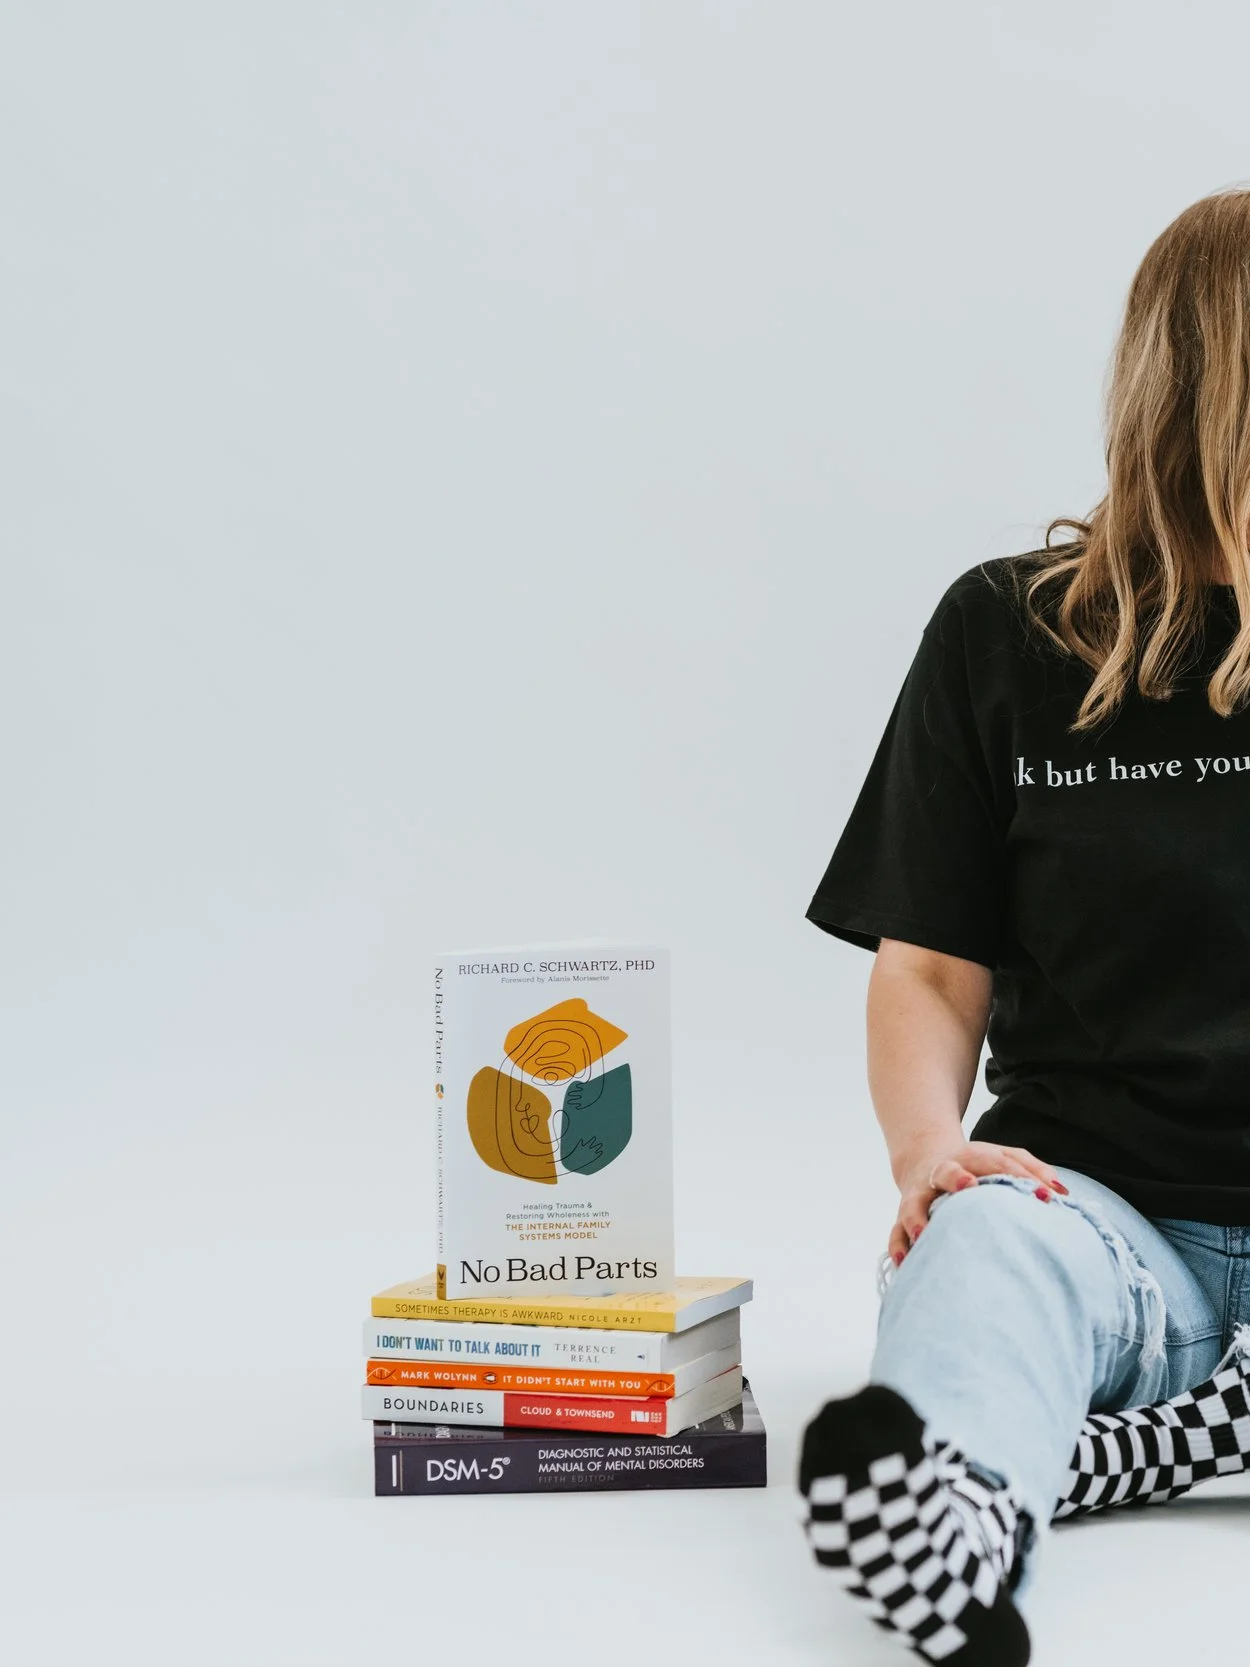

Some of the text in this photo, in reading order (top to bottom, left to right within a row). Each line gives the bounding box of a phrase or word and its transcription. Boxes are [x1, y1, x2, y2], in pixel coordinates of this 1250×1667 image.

[1013, 757, 1036, 787] k
[1045, 760, 1098, 788] but
[1108, 757, 1183, 780] have
[458, 960, 655, 975] RICHARD C. SCHWARTZ, PHD
[435, 968, 444, 1074] No Bad Parts
[523, 1203, 553, 1211] Healing
[556, 1202, 585, 1210] Trauma
[527, 1222, 574, 1230] INTERNAL
[577, 1221, 611, 1229] FAMILY
[519, 1231, 598, 1241] SYSTEMS MODEL
[460, 1256, 657, 1284] No Bad Parts
[395, 1303, 563, 1321] SOMETIMES THERAPY IS AWKWARD
[569, 1314, 609, 1322] NICOLE
[383, 1335, 411, 1349] DON'T
[415, 1337, 444, 1352] WANT
[448, 1340, 461, 1352] TO
[465, 1341, 490, 1354] TALK
[495, 1342, 529, 1357] ABOUT
[531, 1344, 541, 1357] IT
[554, 1343, 617, 1355] TERRENCE
[571, 1354, 600, 1364] REAL
[401, 1371, 478, 1382] MARK WOLYNN
[503, 1375, 641, 1389] IT DIDN'T START WITH YOU
[383, 1397, 485, 1415] BOUNDARIES
[520, 1406, 615, 1419] CLOUD & TOWNSEND
[538, 1445, 693, 1459] DIAGNOSTIC AND STATISTICAL
[538, 1458, 704, 1473] MANUAL OF MENTAL DISORDERS
[538, 1475, 614, 1484] FIFTH EDITION
